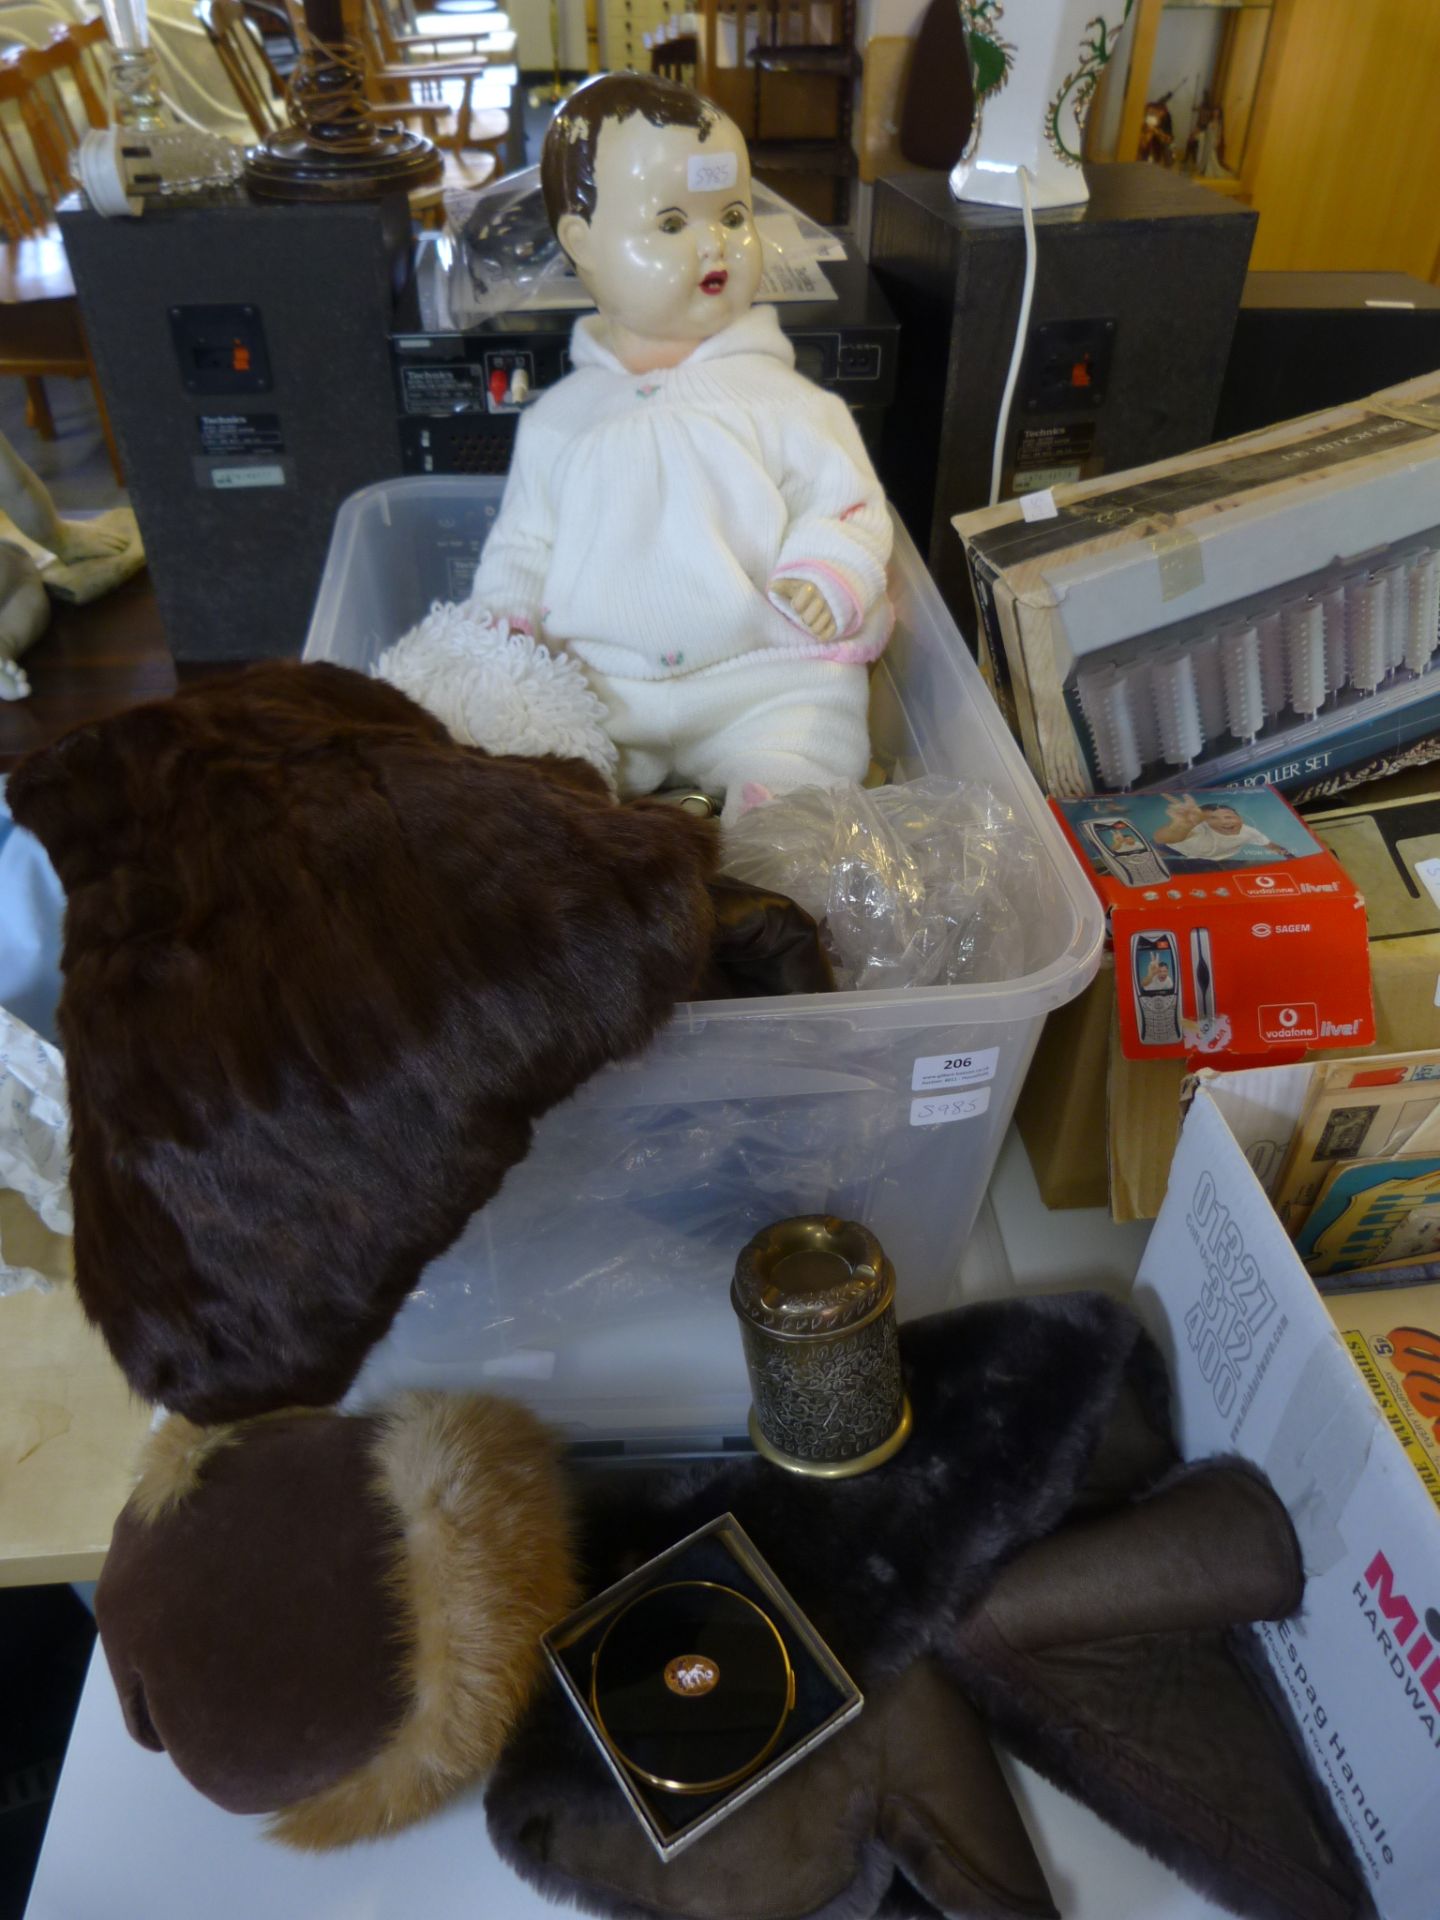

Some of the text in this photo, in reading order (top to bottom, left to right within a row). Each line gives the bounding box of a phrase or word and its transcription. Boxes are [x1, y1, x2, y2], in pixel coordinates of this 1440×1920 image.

[1023, 427, 1066, 438] Technics
[1244, 752, 1332, 788] ROLLER SET
[1247, 885, 1295, 896] vodafone
[1274, 923, 1311, 934] SAGEM
[1265, 1028, 1313, 1039] vodafone
[943, 1057, 972, 1070] 206
[1193, 1170, 1278, 1338] 01327
[1200, 1263, 1254, 1381] 312
[1183, 1302, 1238, 1418] 400
[1347, 1339, 1394, 1410] STORIES
[1385, 1370, 1418, 1418] THURSDAY
[1386, 1412, 1414, 1448] WAR
[1411, 1416, 1435, 1449] EVERY
[1352, 1580, 1440, 1749] HARDWA
[1277, 1619, 1395, 1866] Espag Handle
